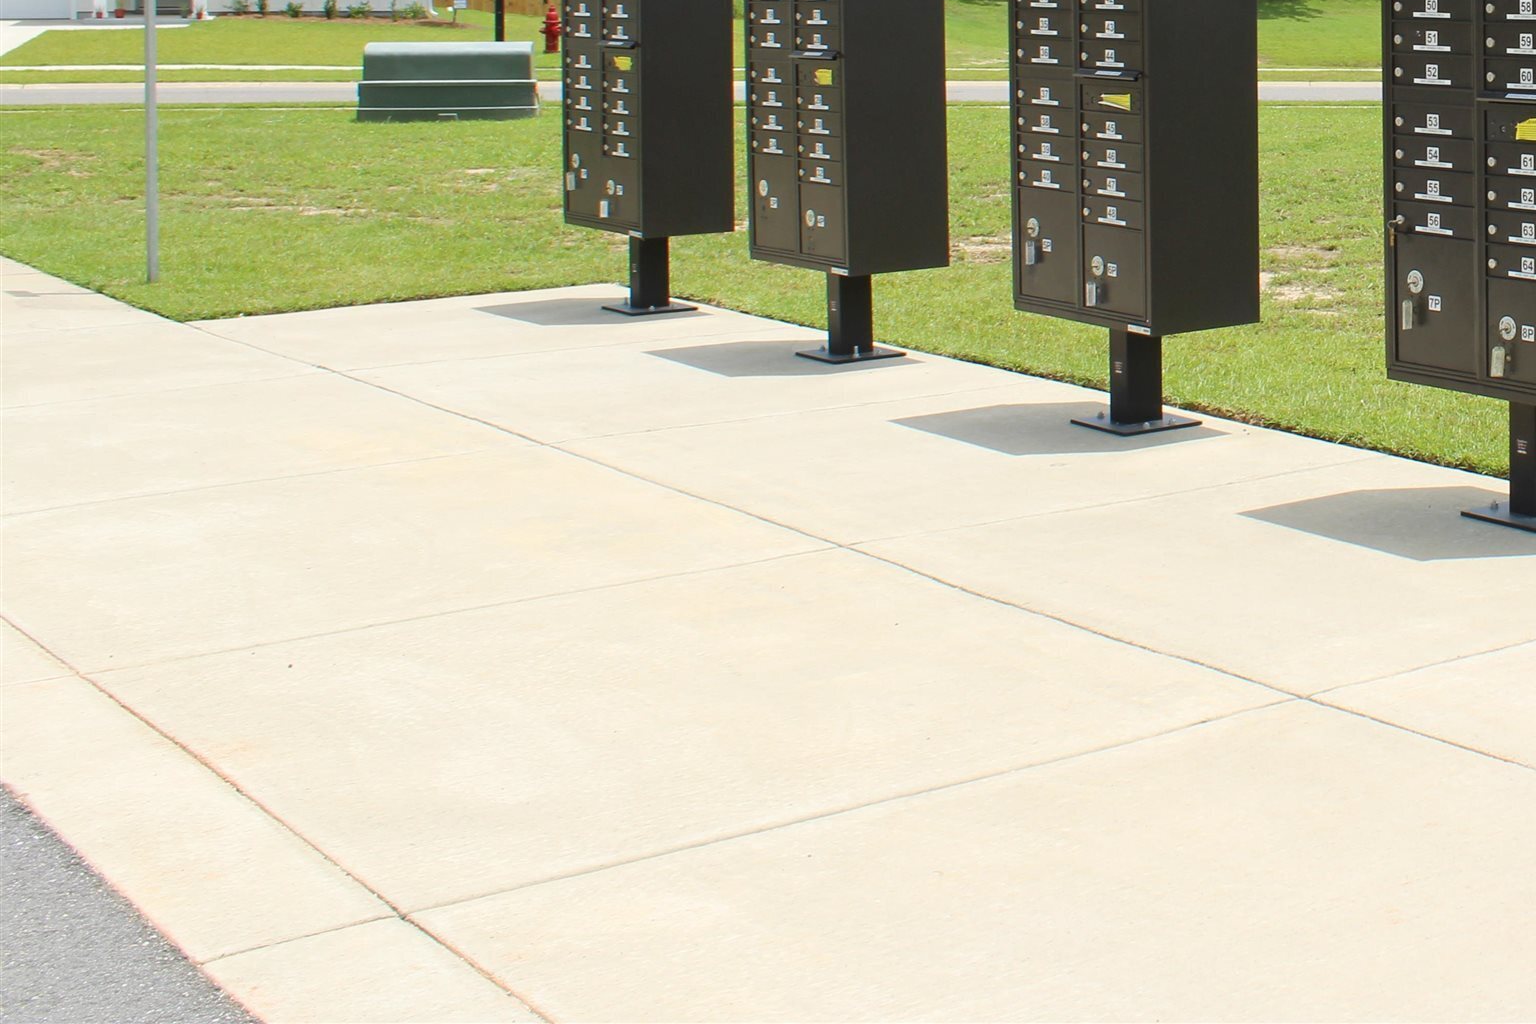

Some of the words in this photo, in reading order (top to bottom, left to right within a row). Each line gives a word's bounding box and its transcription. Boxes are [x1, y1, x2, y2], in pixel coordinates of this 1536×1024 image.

[1427, 0, 1436, 10] 50
[1521, 2, 1531, 12] 58
[1428, 33, 1436, 44] 51
[1521, 36, 1531, 47] 59
[1428, 66, 1436, 77] 52
[1521, 71, 1532, 82] 60
[1428, 116, 1437, 126] 53
[1428, 149, 1438, 159] 54
[1523, 156, 1532, 167] 61
[1428, 182, 1438, 193] 55
[1522, 191, 1533, 202] 62
[1429, 216, 1438, 226] 56
[1523, 225, 1533, 236] 63
[1523, 260, 1533, 271] 64
[1430, 298, 1440, 308] 7P
[1522, 328, 1534, 338] 8P
